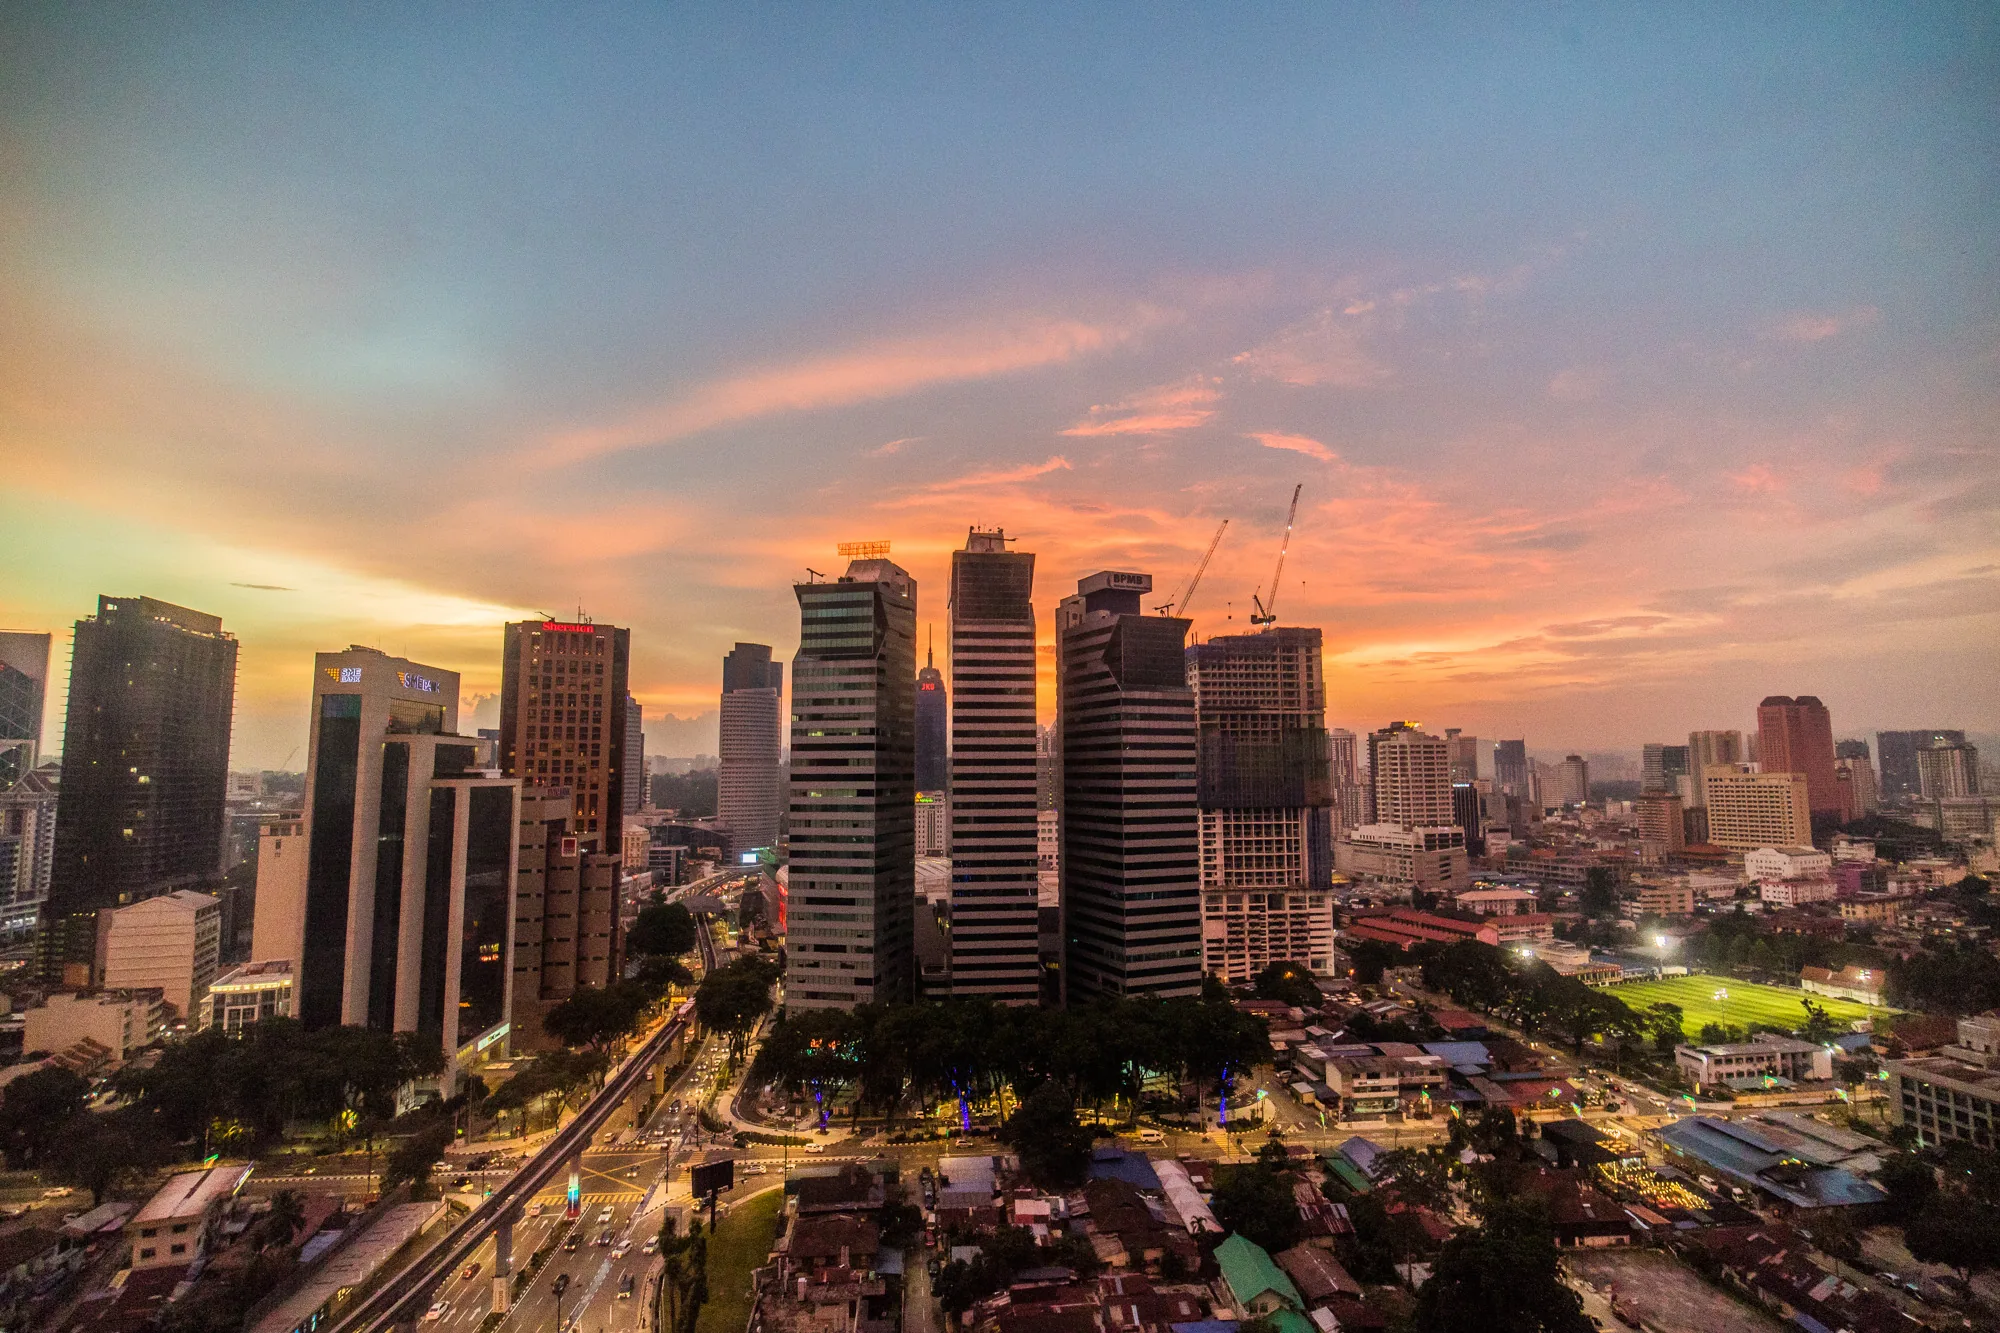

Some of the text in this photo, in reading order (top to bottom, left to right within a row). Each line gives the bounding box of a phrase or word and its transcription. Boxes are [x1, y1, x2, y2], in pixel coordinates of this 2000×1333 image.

[1114, 574, 1143, 585] BPMB
[542, 622, 594, 633] Sheraton
[341, 668, 361, 676] SME
[404, 672, 424, 690] SME
